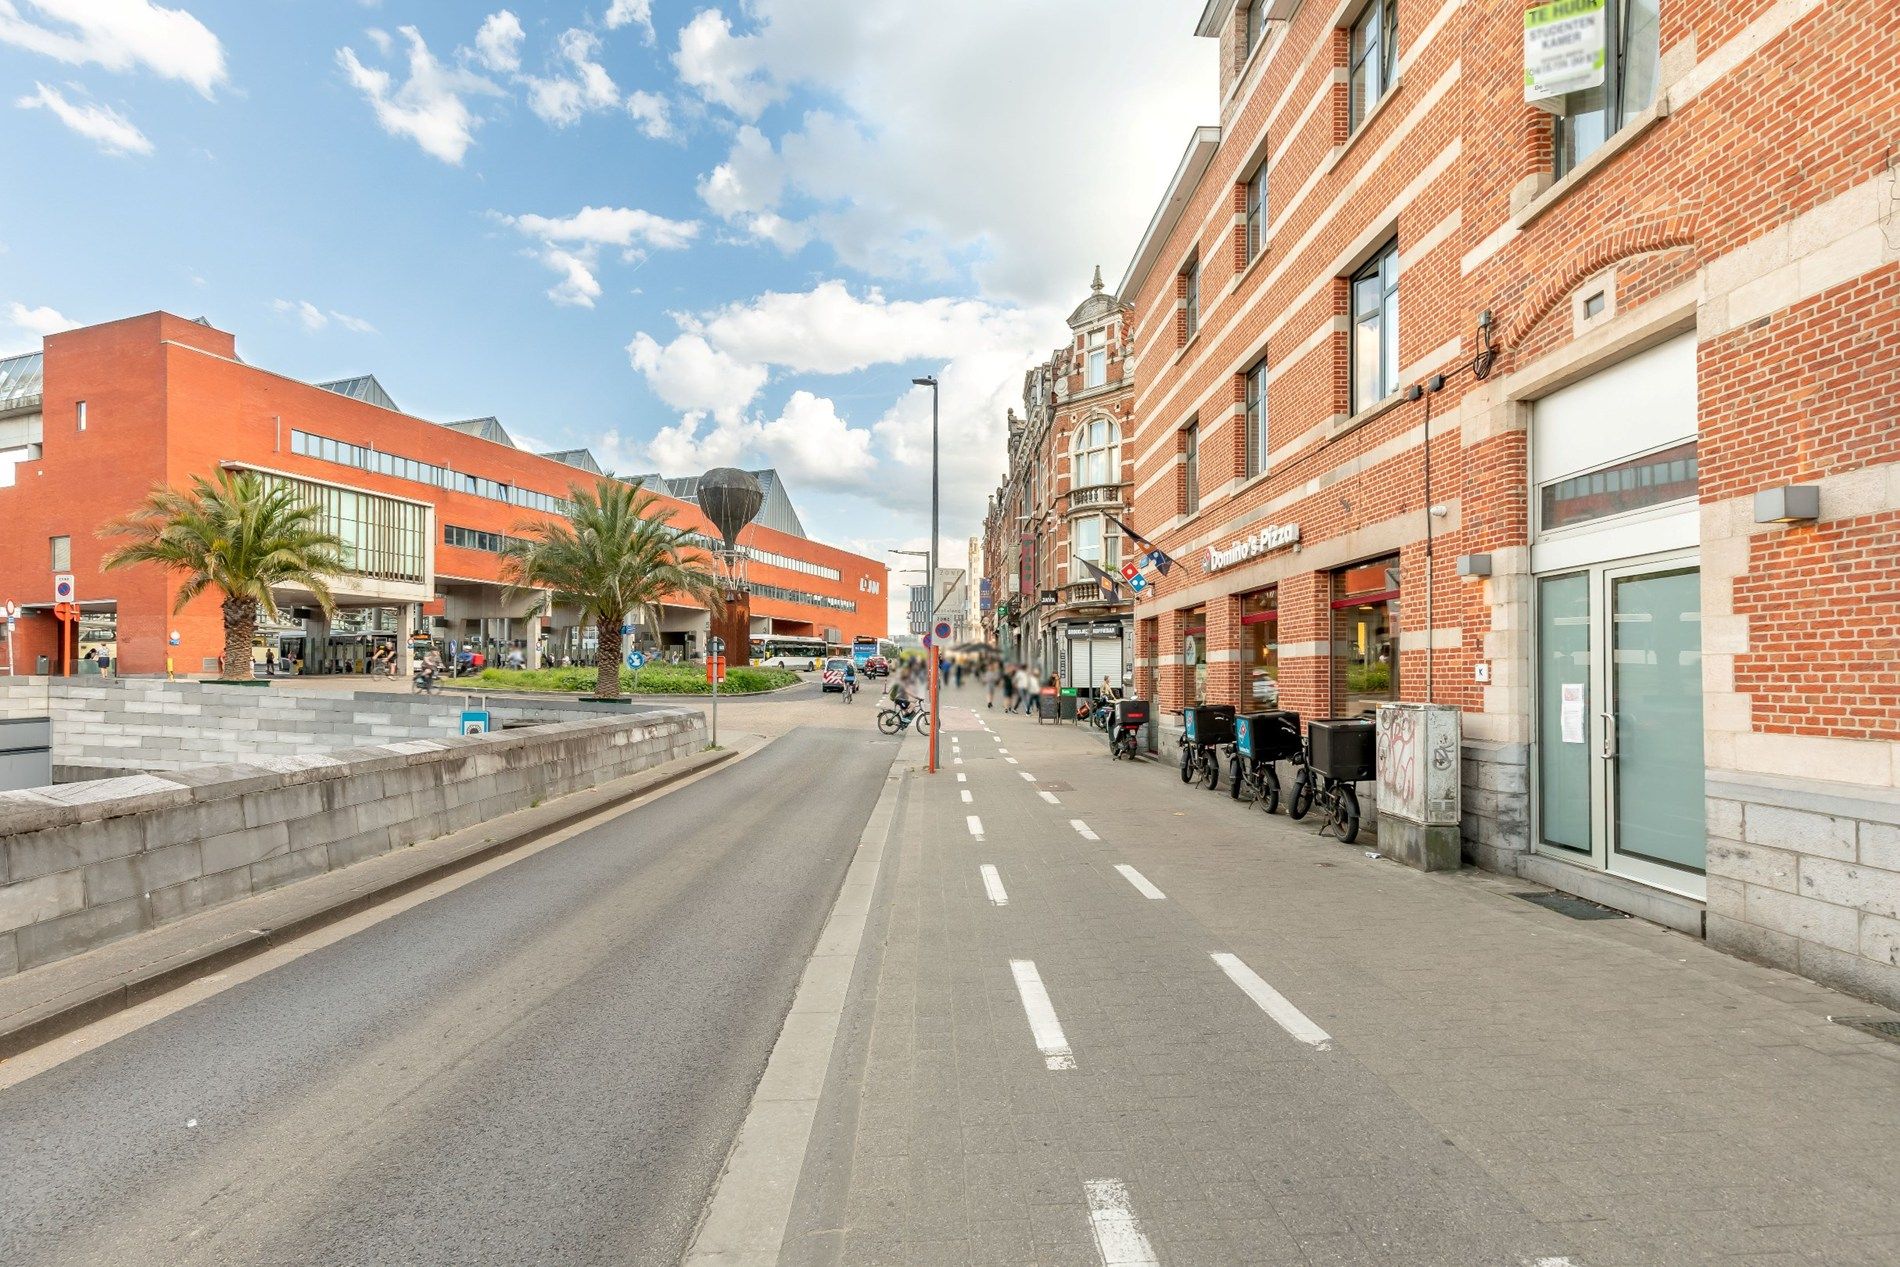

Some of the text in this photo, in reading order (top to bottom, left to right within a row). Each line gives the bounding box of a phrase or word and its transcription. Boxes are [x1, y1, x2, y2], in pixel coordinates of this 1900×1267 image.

[1529, 11, 1545, 24] TE
[1210, 523, 1297, 571] Domino's Pizza
